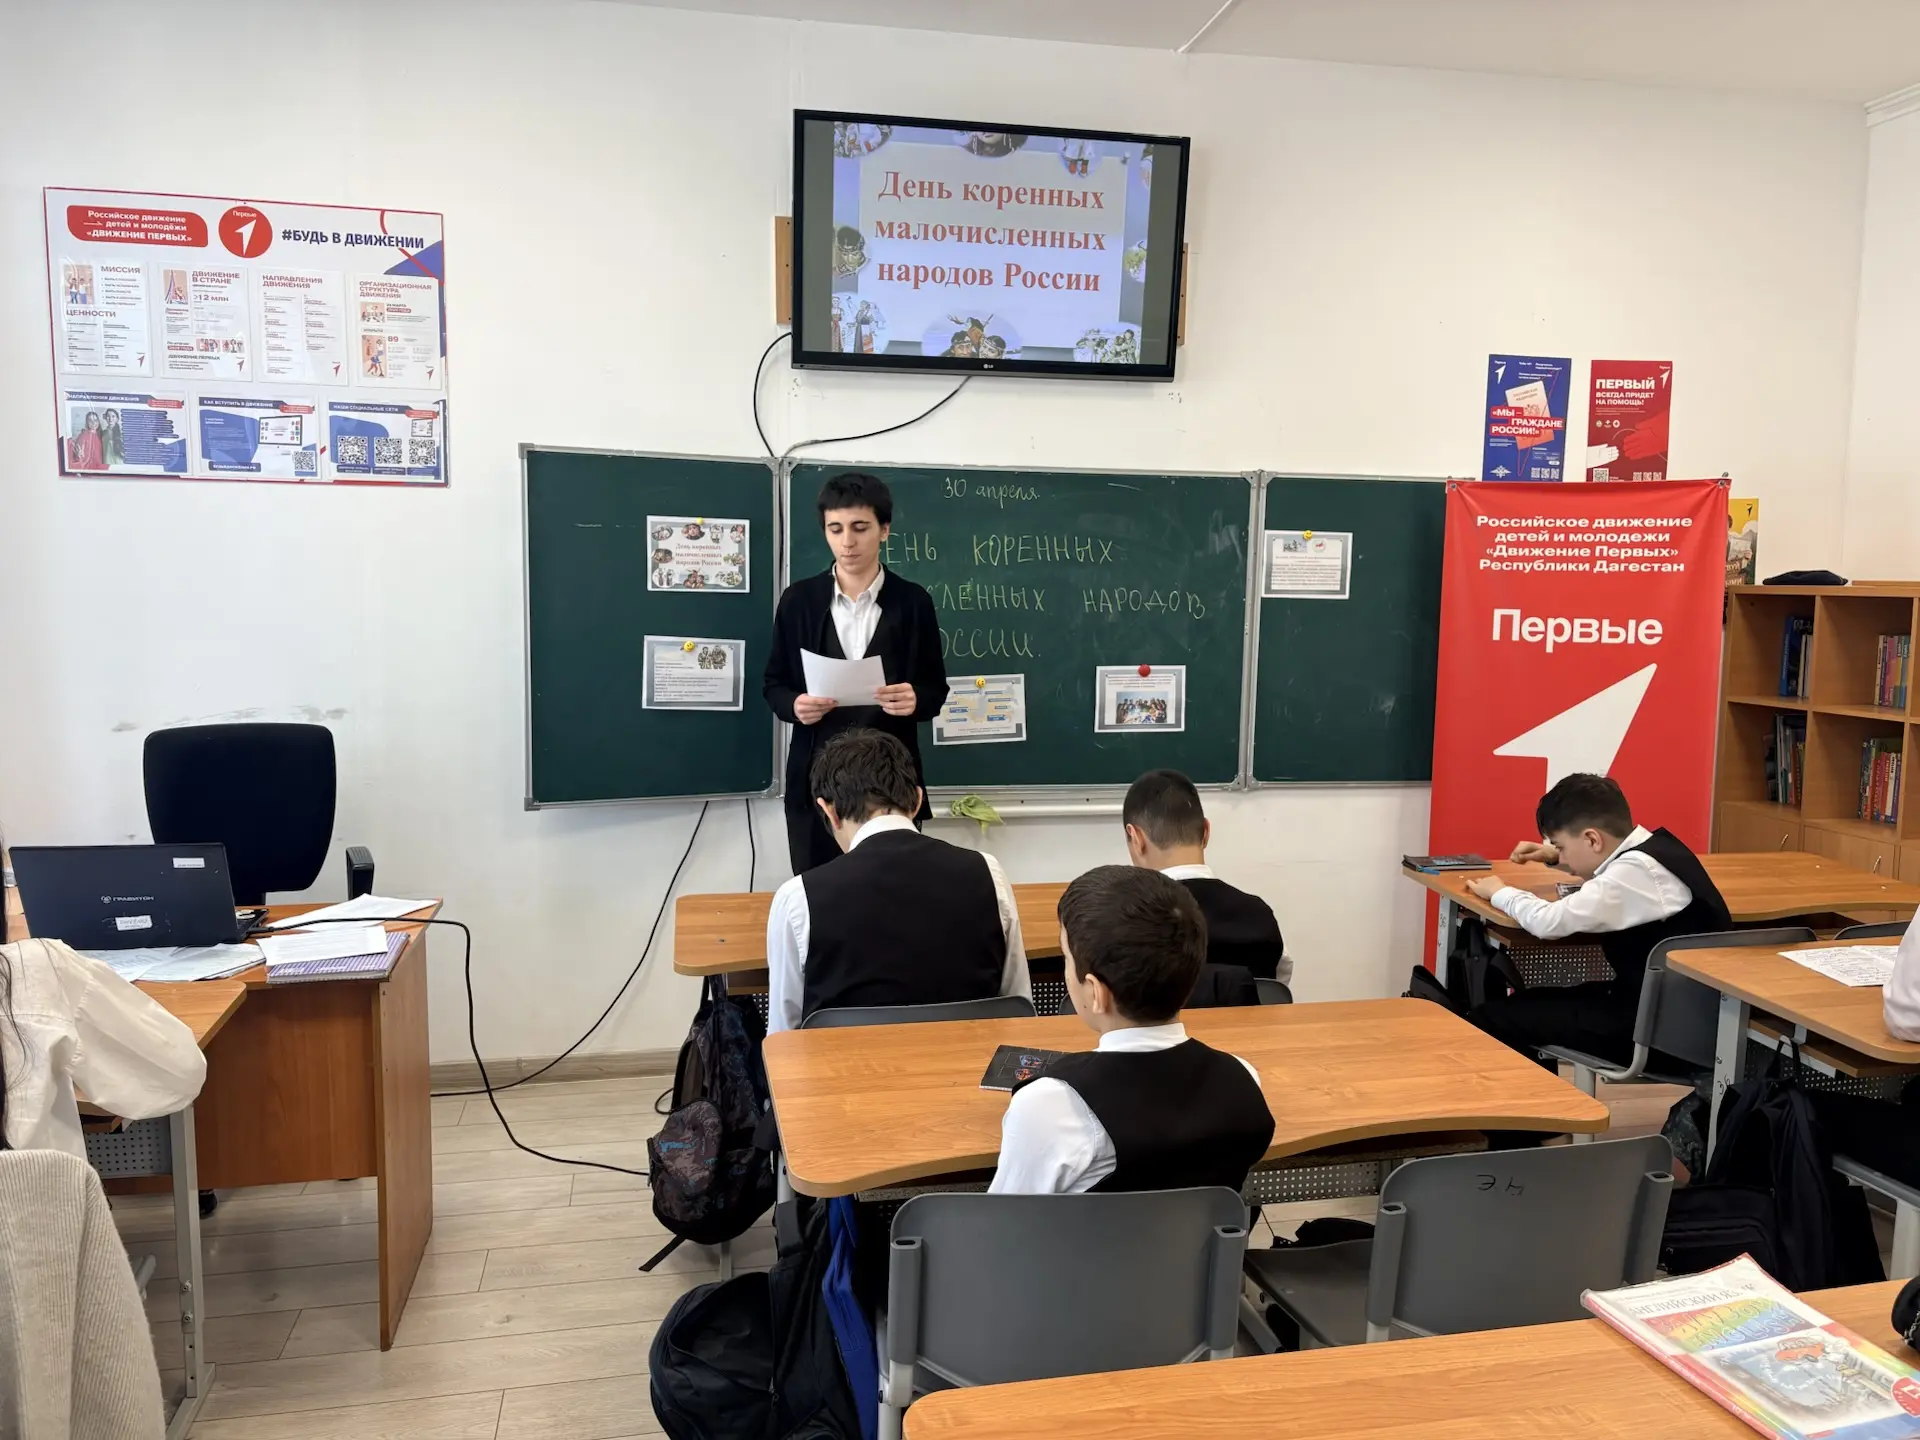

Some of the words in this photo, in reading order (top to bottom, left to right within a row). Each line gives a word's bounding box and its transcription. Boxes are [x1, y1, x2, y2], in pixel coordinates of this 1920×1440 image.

[878, 171, 952, 201] День
[963, 182, 1104, 210] коренных
[88, 211, 139, 221] Российское
[142, 215, 186, 223] движение
[141, 222, 187, 231] молодёжи
[86, 230, 145, 239] «ДВИЖЕНИЕ
[148, 233, 192, 242] ПЕРВЫХ»
[282, 229, 328, 245] #БУДЬ
[332, 233, 341, 243] В
[344, 233, 424, 249] ДВИЖЕНИИ
[874, 220, 1106, 250] малочисленных
[101, 266, 140, 274] МИССИЯ
[192, 271, 240, 279] ДВИЖЕНИЕ
[878, 262, 993, 289] народов
[1003, 262, 1101, 291] России
[262, 274, 323, 284] НАПРАВЛЕНИЯ
[262, 281, 310, 289] ДВИЖЕНИЯ
[66, 310, 116, 318] ЦЕННОСТИ
[1595, 376, 1655, 390] ПЕРВЫЙ
[1492, 408, 1515, 417] «МЫ
[1511, 418, 1563, 428] ГРАЖДАНЕ
[1491, 426, 1540, 435] РОССИИ!»
[943, 477, 967, 499] 30
[1476, 515, 1589, 528] Российское
[1592, 516, 1692, 529] движение
[1495, 531, 1550, 543] детей
[1553, 532, 1564, 542] и
[1569, 532, 1670, 544] молодежи
[879, 533, 937, 565] ЕНЬ
[973, 533, 1113, 566] КОРЕННЫХ
[1486, 545, 1591, 558] «Движение
[1595, 546, 1679, 559] Первых»
[1479, 559, 1590, 573] Республики
[1593, 560, 1685, 574] Дагестан
[1083, 587, 1206, 619] НАРОДОВ
[1492, 608, 1663, 653] Первые
